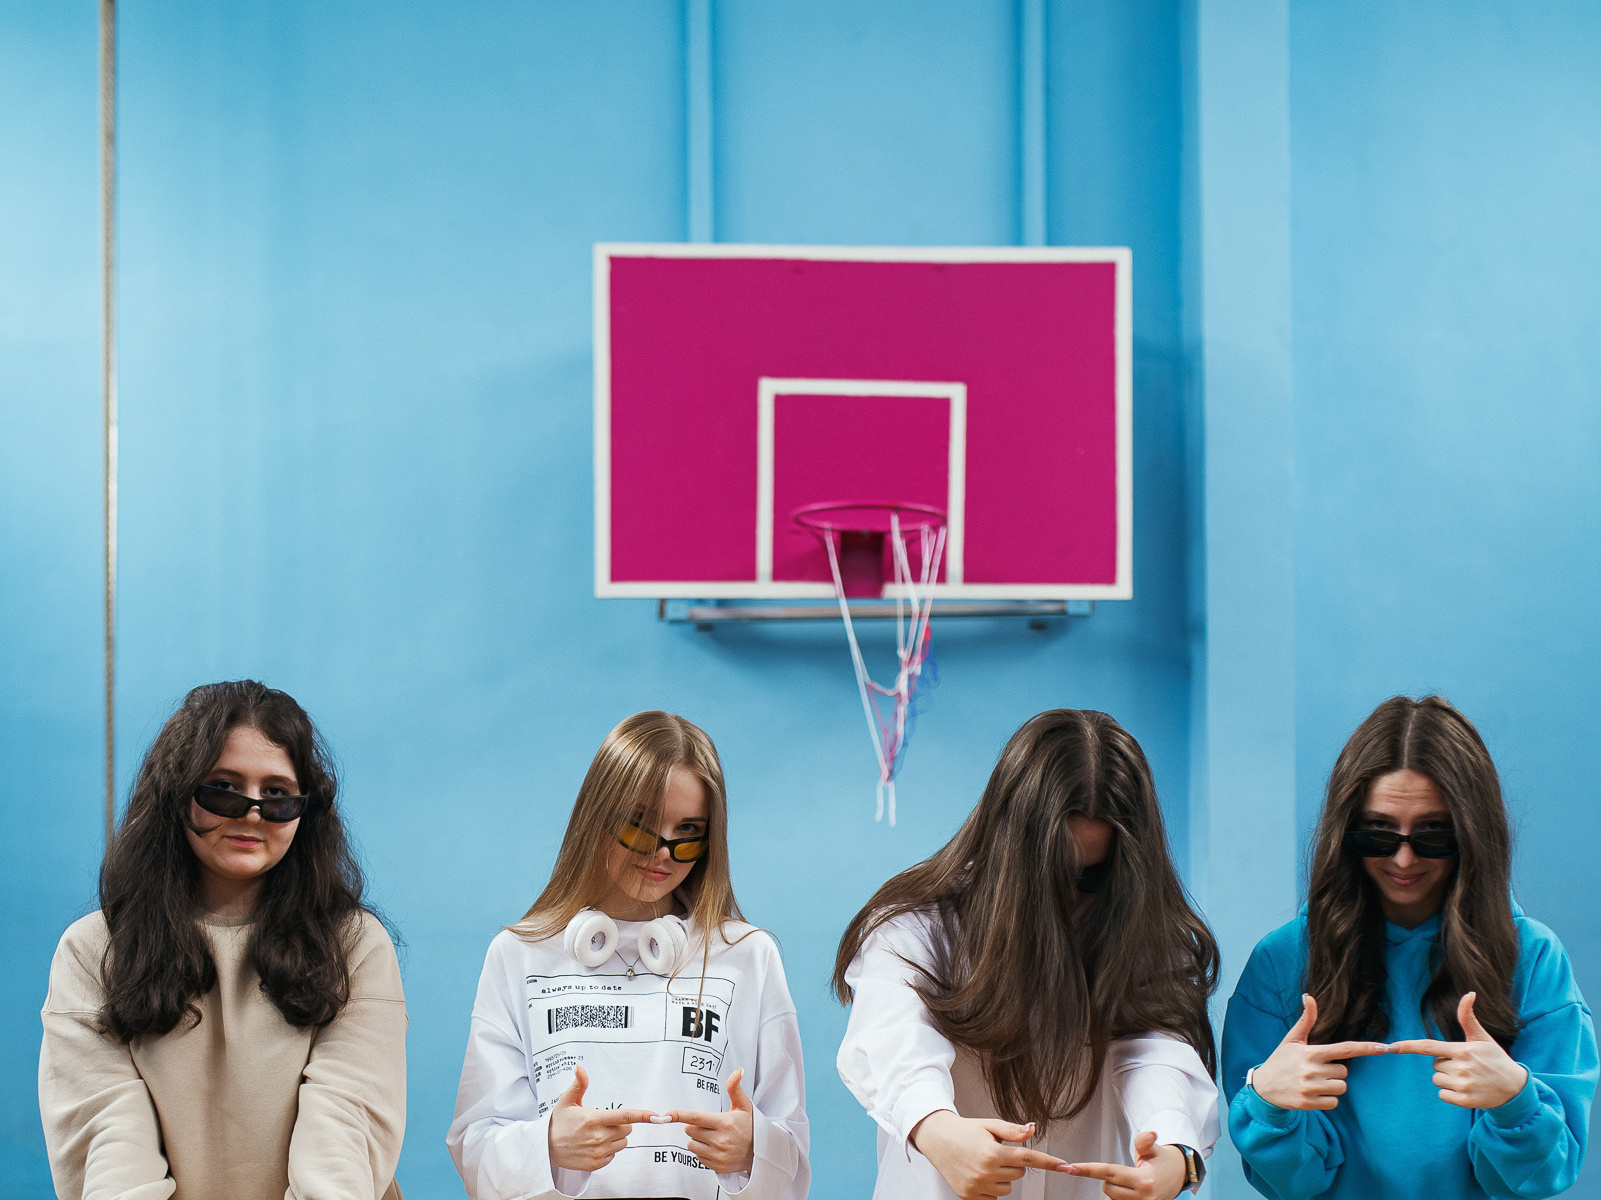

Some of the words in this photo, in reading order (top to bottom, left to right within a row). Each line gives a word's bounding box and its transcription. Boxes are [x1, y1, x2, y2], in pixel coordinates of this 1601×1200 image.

[541, 985, 572, 994] always
[682, 1006, 721, 1043] BF
[696, 1078, 706, 1090] BE
[654, 1151, 668, 1163] BE
